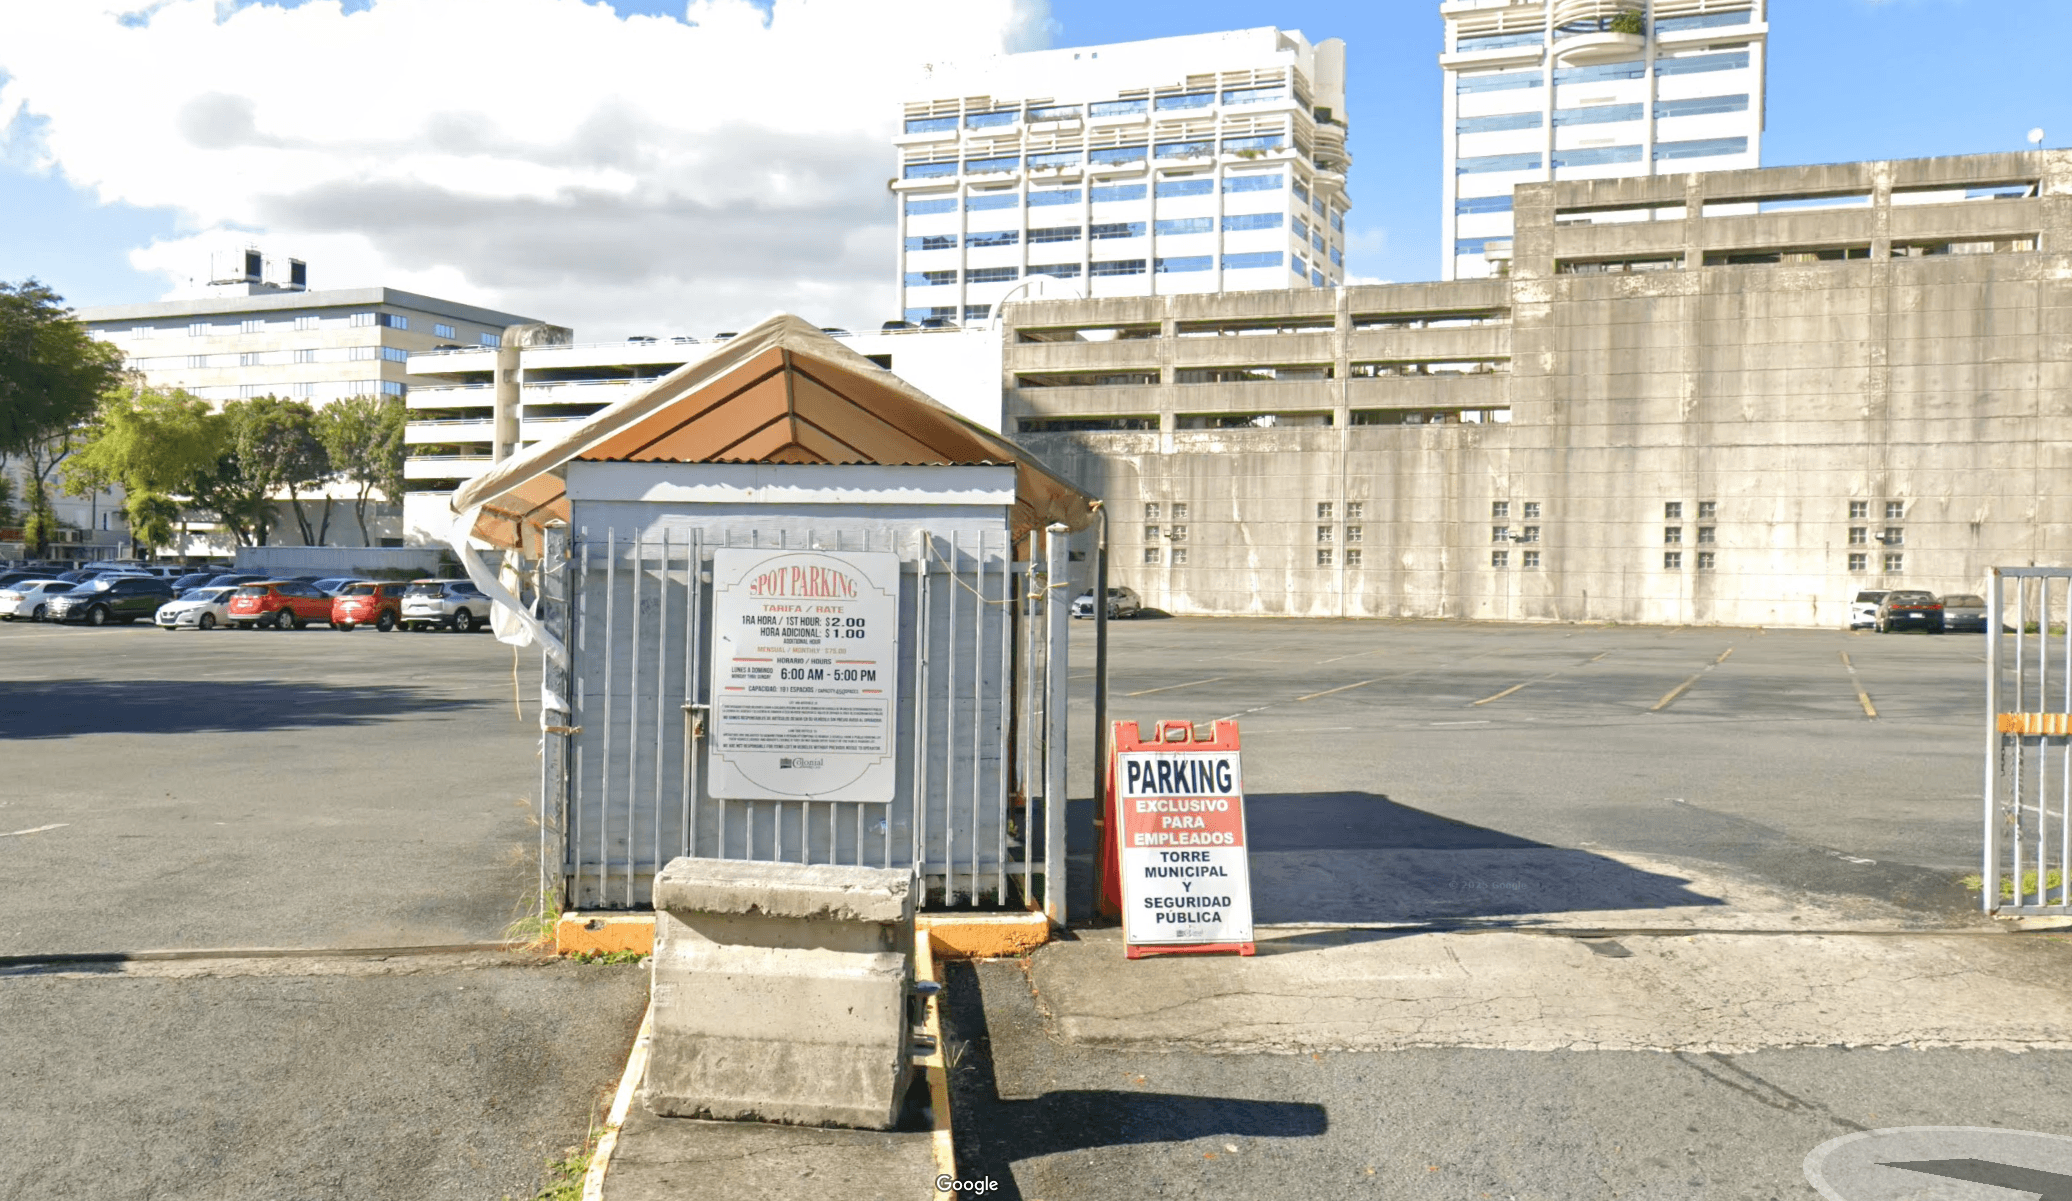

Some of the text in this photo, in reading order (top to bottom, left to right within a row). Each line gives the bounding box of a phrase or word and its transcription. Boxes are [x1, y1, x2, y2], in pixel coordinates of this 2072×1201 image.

[750, 566, 858, 598] SPOT PARKING
[816, 606, 844, 614] RATE
[742, 616, 756, 624] 1RA
[758, 616, 776, 625] HORA
[786, 616, 798, 626] 1ST
[800, 617, 822, 626] HOUR:
[760, 628, 780, 636] HORA
[782, 628, 822, 638] ADICIONAL:
[781, 668, 804, 680] 6:00
[808, 668, 824, 680] AM
[834, 669, 858, 681] 5:00
[860, 670, 876, 682] PM
[1128, 760, 1232, 794] PARKING
[1136, 800, 1228, 812] EXCLUSIVO
[1162, 816, 1205, 828] PARA
[1134, 832, 1234, 846] EMPLEADOS
[1160, 852, 1210, 862] TORRE
[1145, 866, 1228, 878] MUNICIPAL
[1182, 882, 1192, 892] Y
[1144, 896, 1231, 908] SEGURIDAD
[1156, 910, 1222, 923] PÚBLICA
